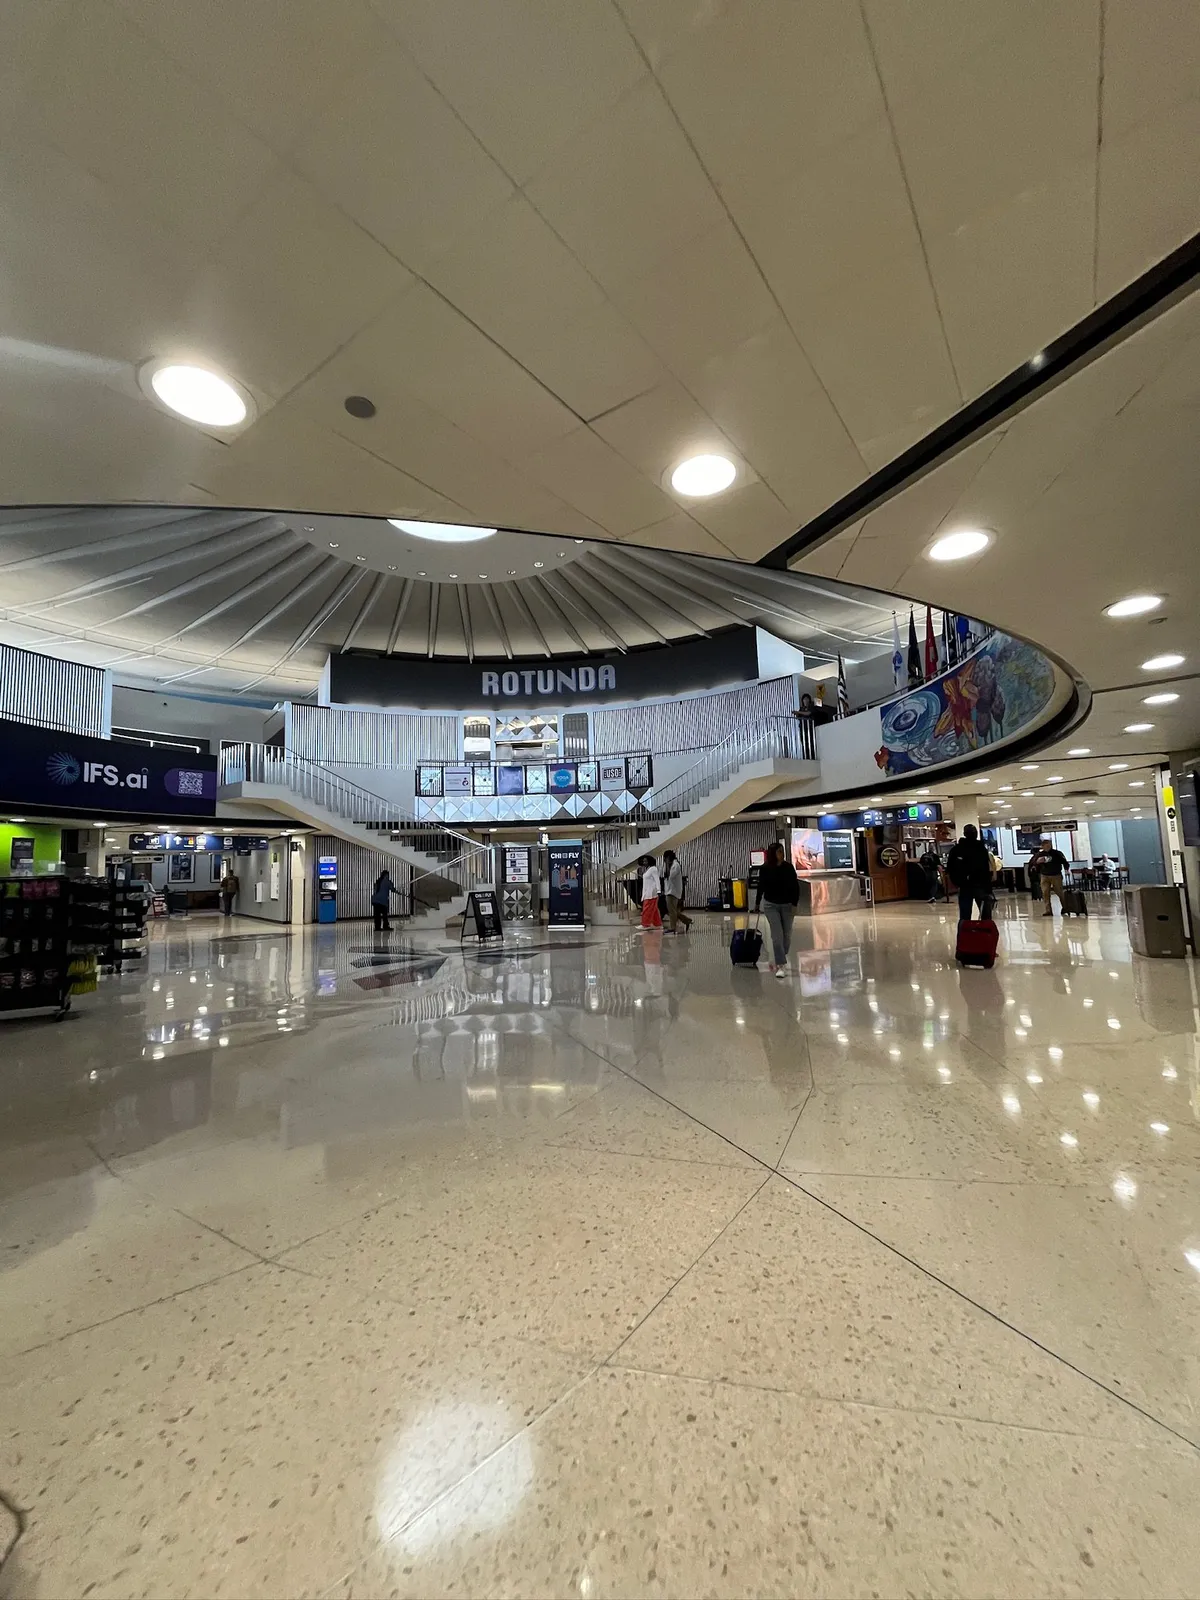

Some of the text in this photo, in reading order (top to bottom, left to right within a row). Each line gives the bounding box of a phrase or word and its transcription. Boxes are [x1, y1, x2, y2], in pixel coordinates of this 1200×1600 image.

[482, 664, 616, 696] ROTUNDA
[83, 761, 149, 789] IFS.ai
[607, 768, 619, 778] USO
